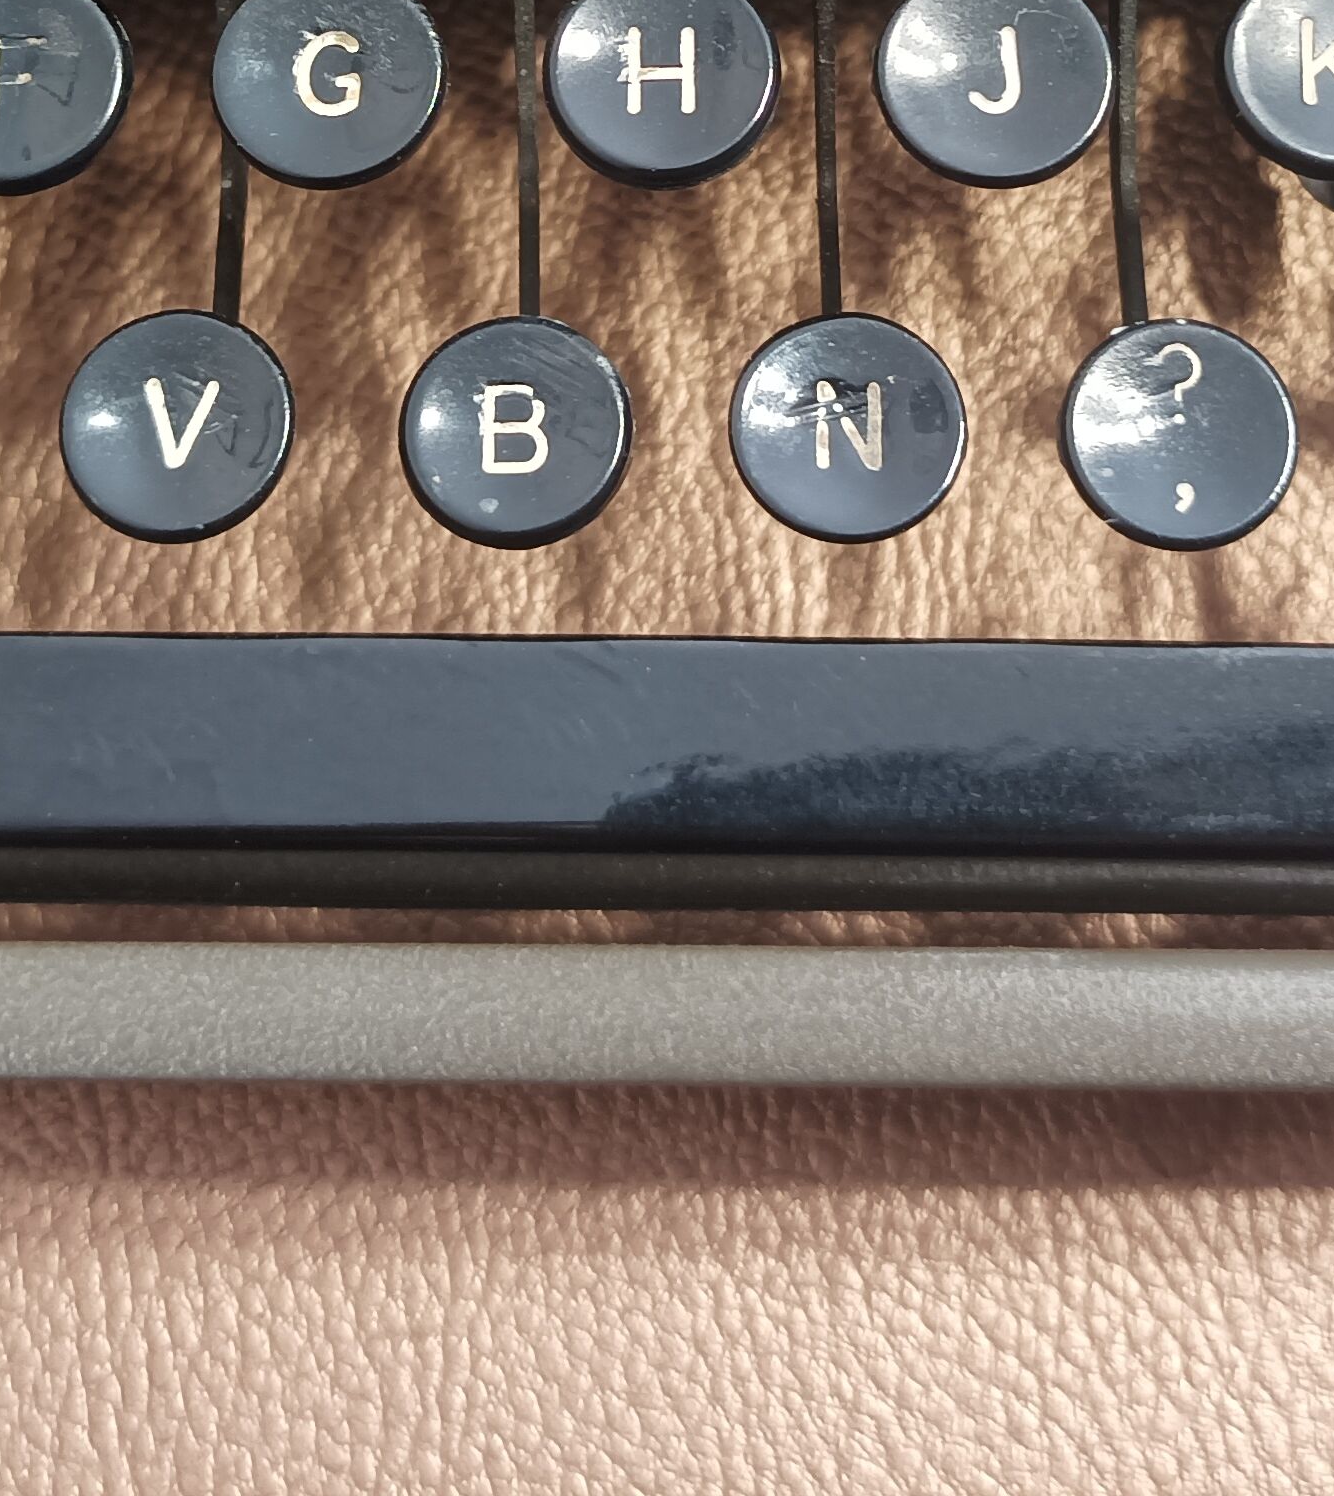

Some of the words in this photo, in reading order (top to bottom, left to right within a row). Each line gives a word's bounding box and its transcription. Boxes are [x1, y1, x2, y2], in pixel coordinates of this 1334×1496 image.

[291, 29, 363, 117] G
[625, 25, 697, 115] H
[966, 25, 1021, 115] J
[142, 376, 221, 470] V
[480, 383, 550, 475] B
[814, 380, 884, 471] N
[1156, 342, 1203, 427] ?
